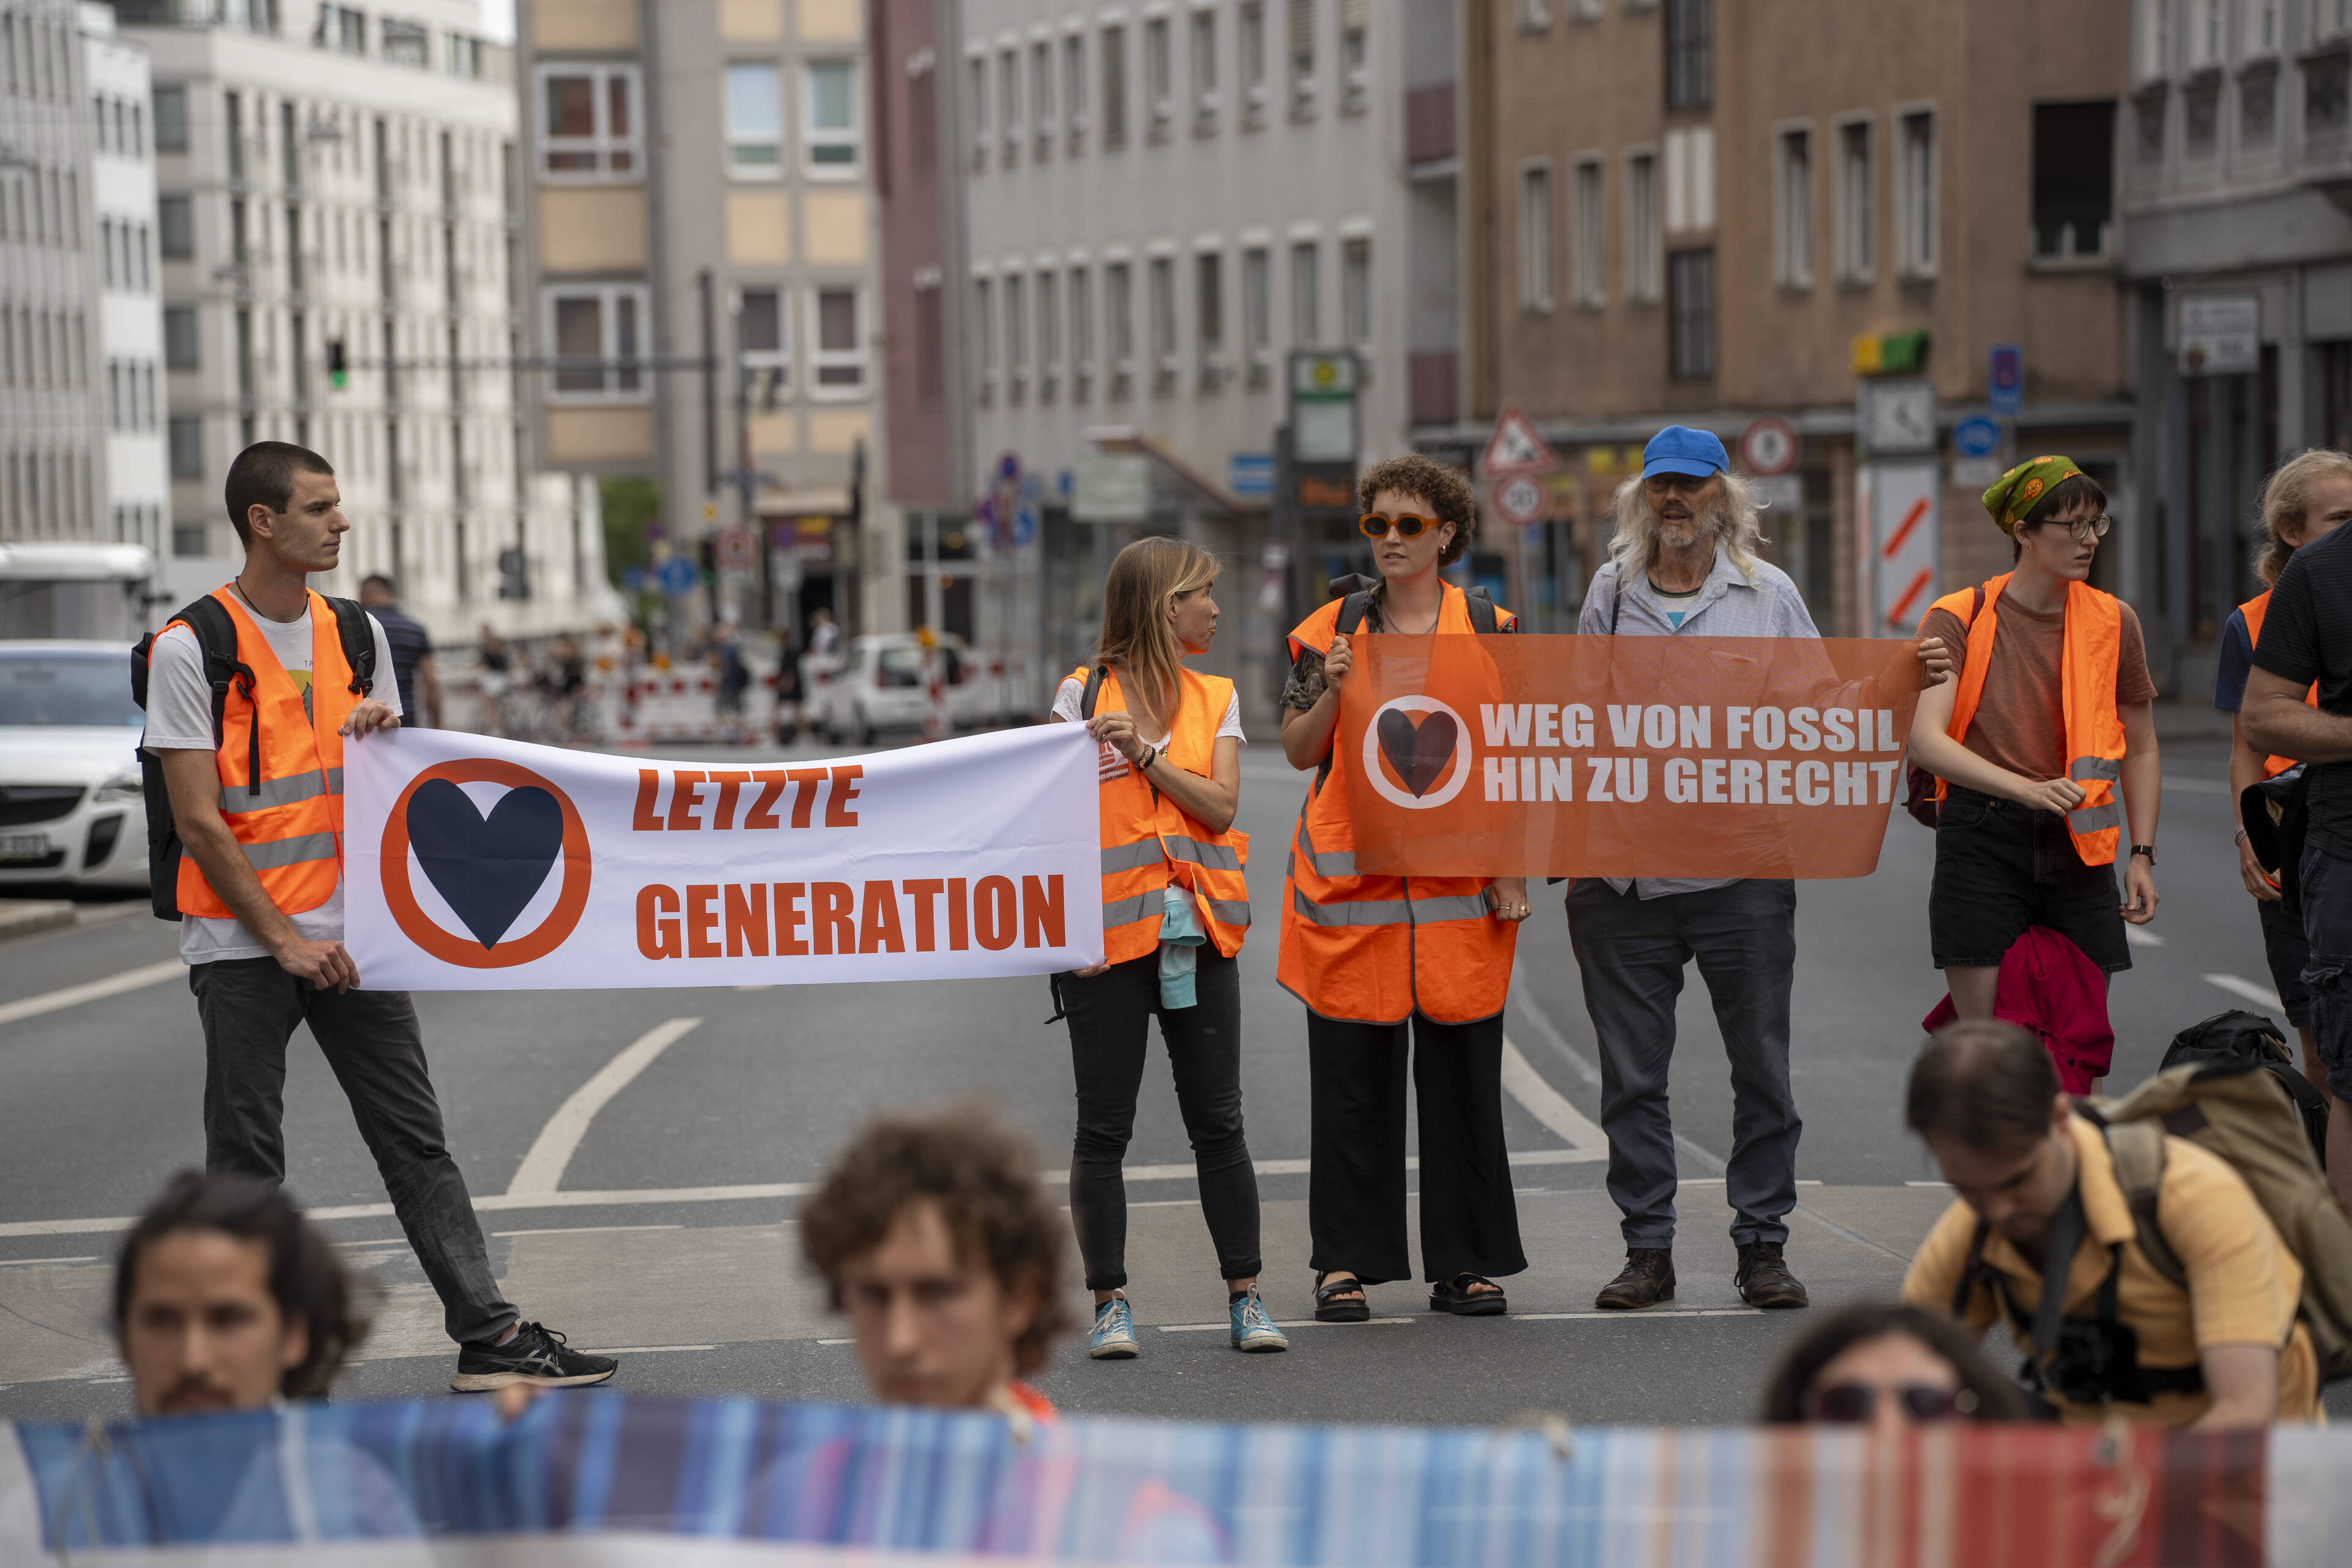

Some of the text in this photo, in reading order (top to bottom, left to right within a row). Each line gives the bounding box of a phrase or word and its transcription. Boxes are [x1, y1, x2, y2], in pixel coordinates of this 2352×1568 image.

[1480, 703, 1899, 752] WEG VON FOSSIL
[1106, 768, 1128, 777] GENERATION
[1483, 757, 1899, 805] HIN ZU GERECHT
[633, 764, 863, 831] LETZTE
[636, 874, 1066, 960] GENERATION
